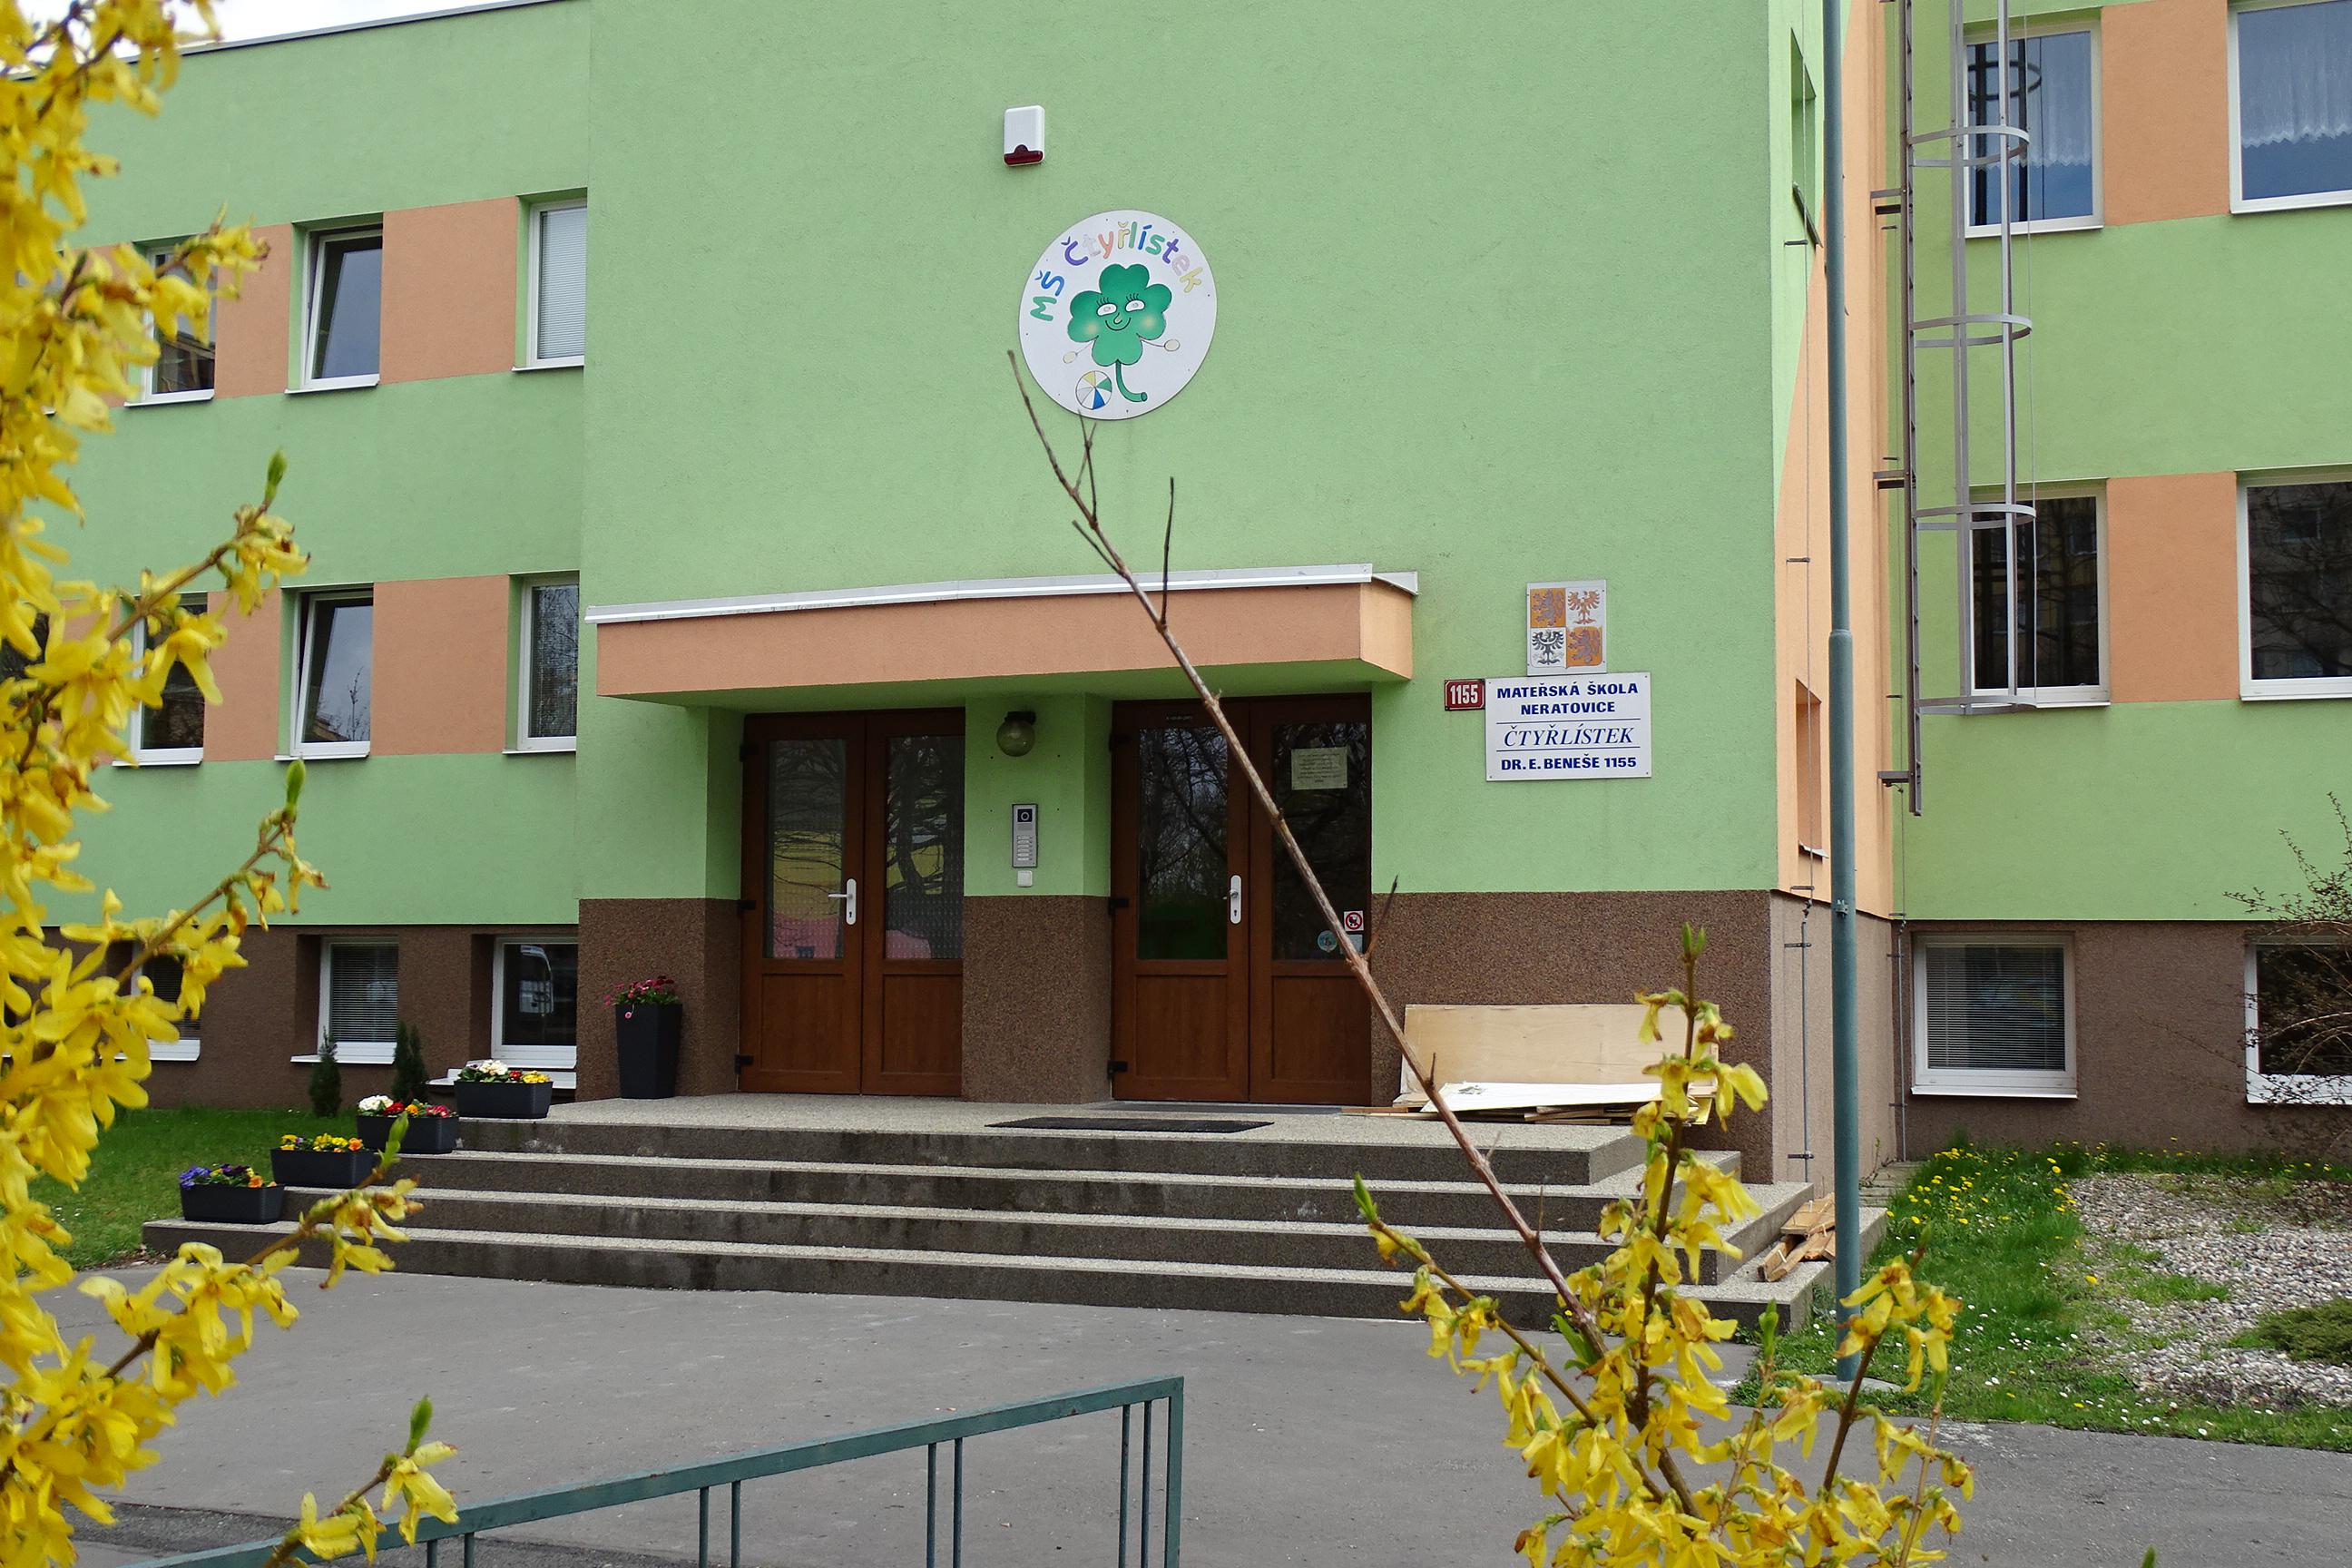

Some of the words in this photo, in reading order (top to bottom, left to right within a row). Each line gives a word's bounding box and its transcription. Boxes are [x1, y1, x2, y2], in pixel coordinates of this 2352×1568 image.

[1030, 270, 1065, 321] MŠ
[1061, 220, 1203, 293] Čtyřlístek
[1450, 684, 1478, 704] 1155
[1496, 681, 1580, 699] MATEŘSKÁ
[1587, 681, 1639, 696] ŠKOLA
[1520, 701, 1615, 715] NERATOVICE
[1504, 723, 1634, 747] ČTYŘLÍSTEK
[1501, 759, 1526, 770] DR.
[1544, 754, 1600, 769] BENEŠE
[1603, 757, 1637, 768] 1155
